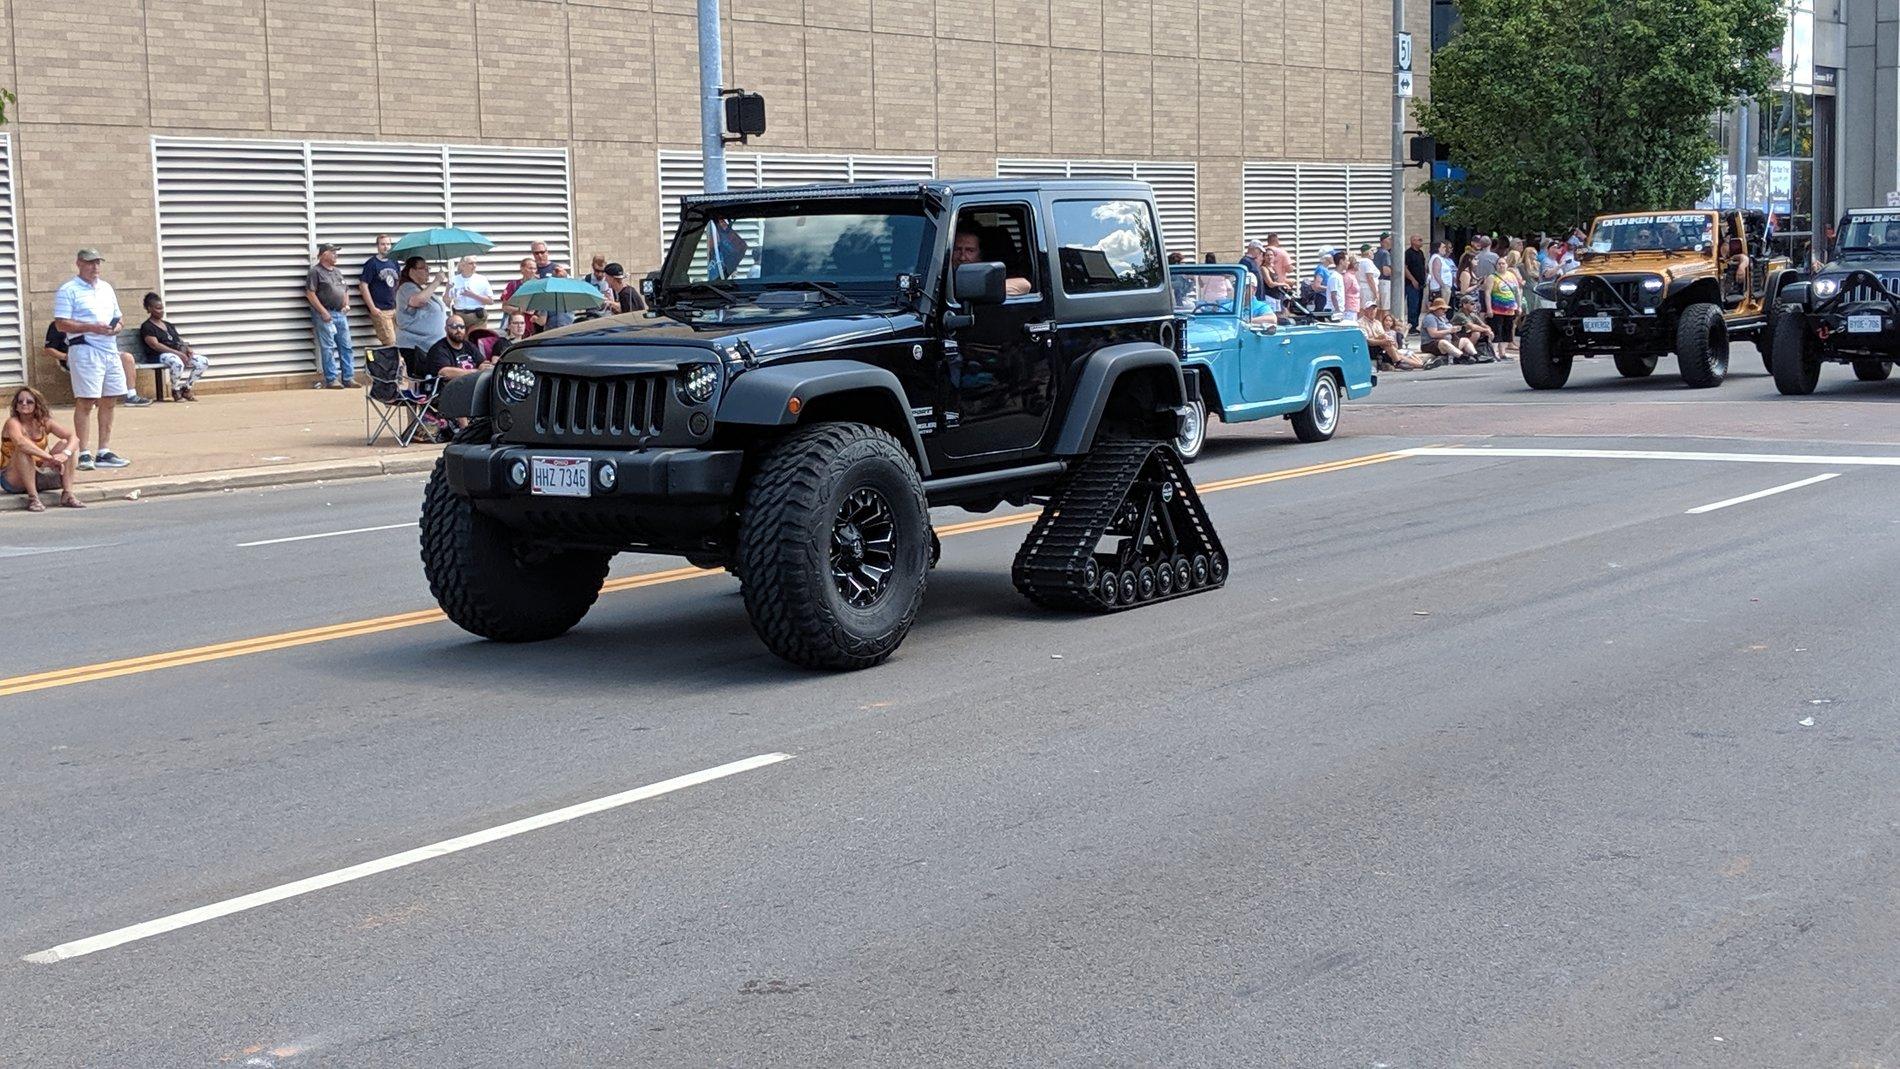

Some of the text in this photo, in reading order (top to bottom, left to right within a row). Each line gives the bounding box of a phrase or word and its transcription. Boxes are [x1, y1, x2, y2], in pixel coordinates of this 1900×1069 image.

[1401, 40, 1410, 62] 51
[1602, 215, 1705, 226] DRUNKEN BEAVERS
[535, 468, 586, 488] HHZ 7346
